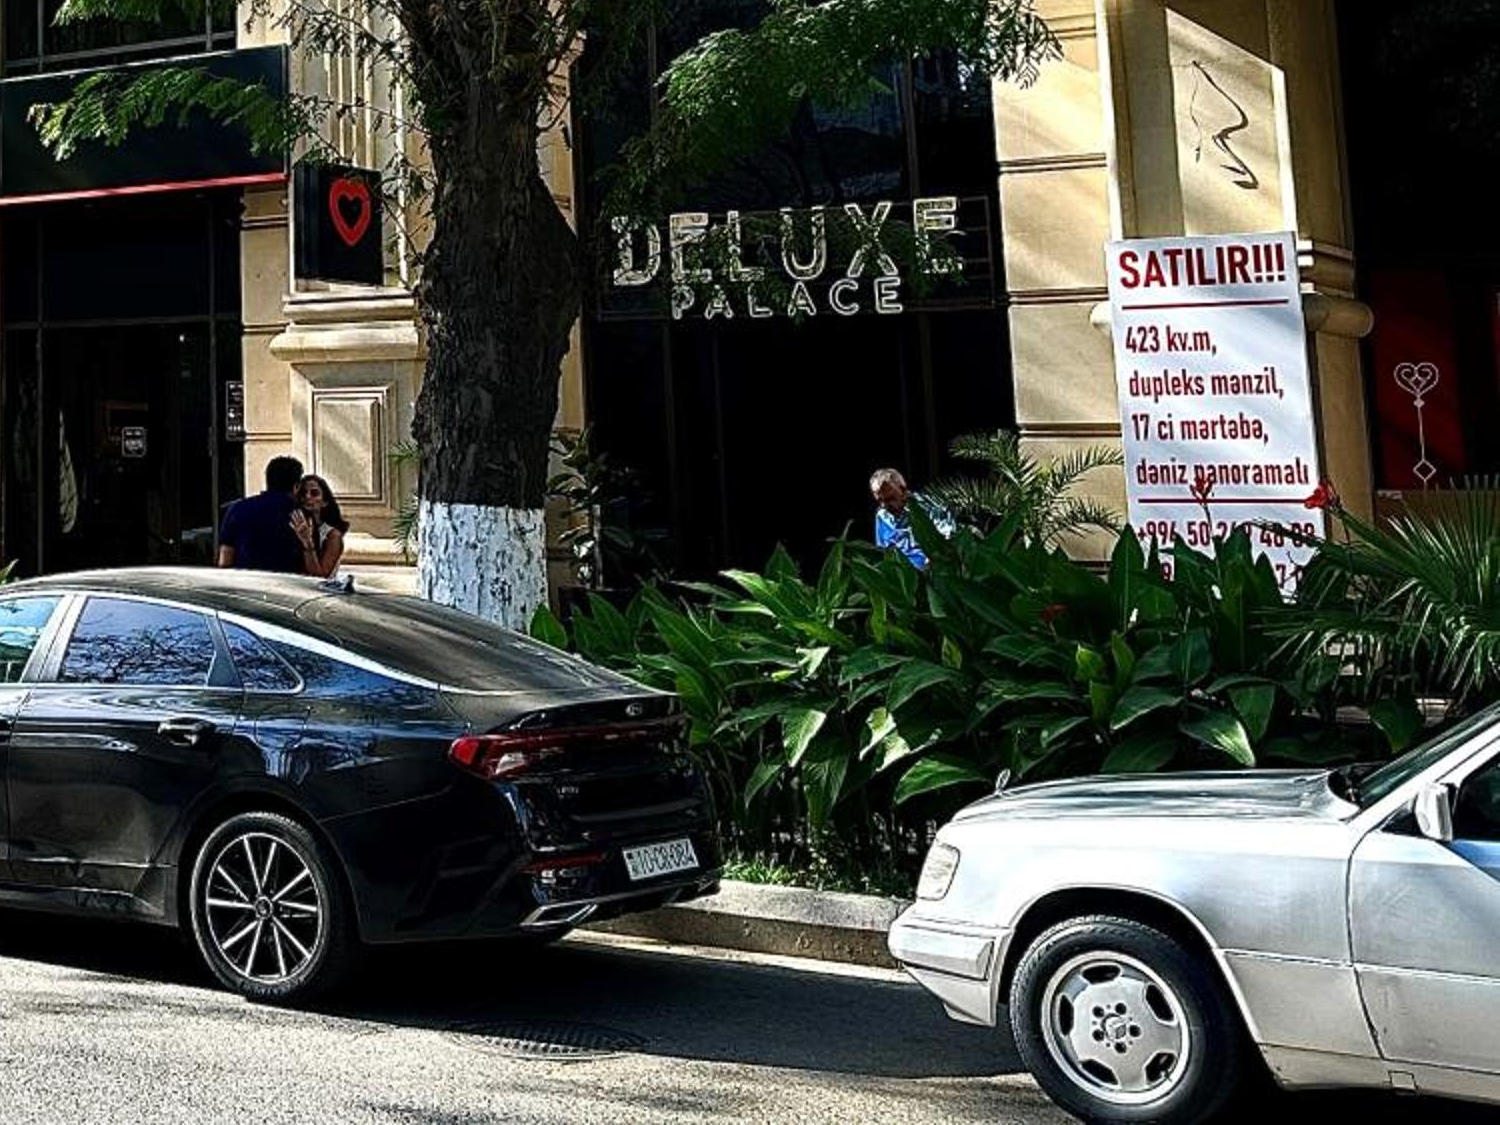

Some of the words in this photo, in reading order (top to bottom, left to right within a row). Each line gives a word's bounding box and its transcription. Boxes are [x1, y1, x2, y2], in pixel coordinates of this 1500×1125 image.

[612, 197, 964, 285] DELUXE
[1119, 243, 1286, 288] SATILIR!!!
[671, 277, 903, 319] PALACE
[1126, 326, 1160, 353] 423
[1166, 325, 1217, 356] kv.m,
[1129, 368, 1204, 403] dupleks
[1211, 367, 1284, 398] mənzil,
[1132, 414, 1150, 441] 17
[1157, 413, 1174, 440] ci
[1181, 413, 1269, 444] mərtəbə,
[1136, 458, 1188, 485] dəniz
[1193, 457, 1309, 487] panoramalı
[1187, 521, 1211, 547] 50
